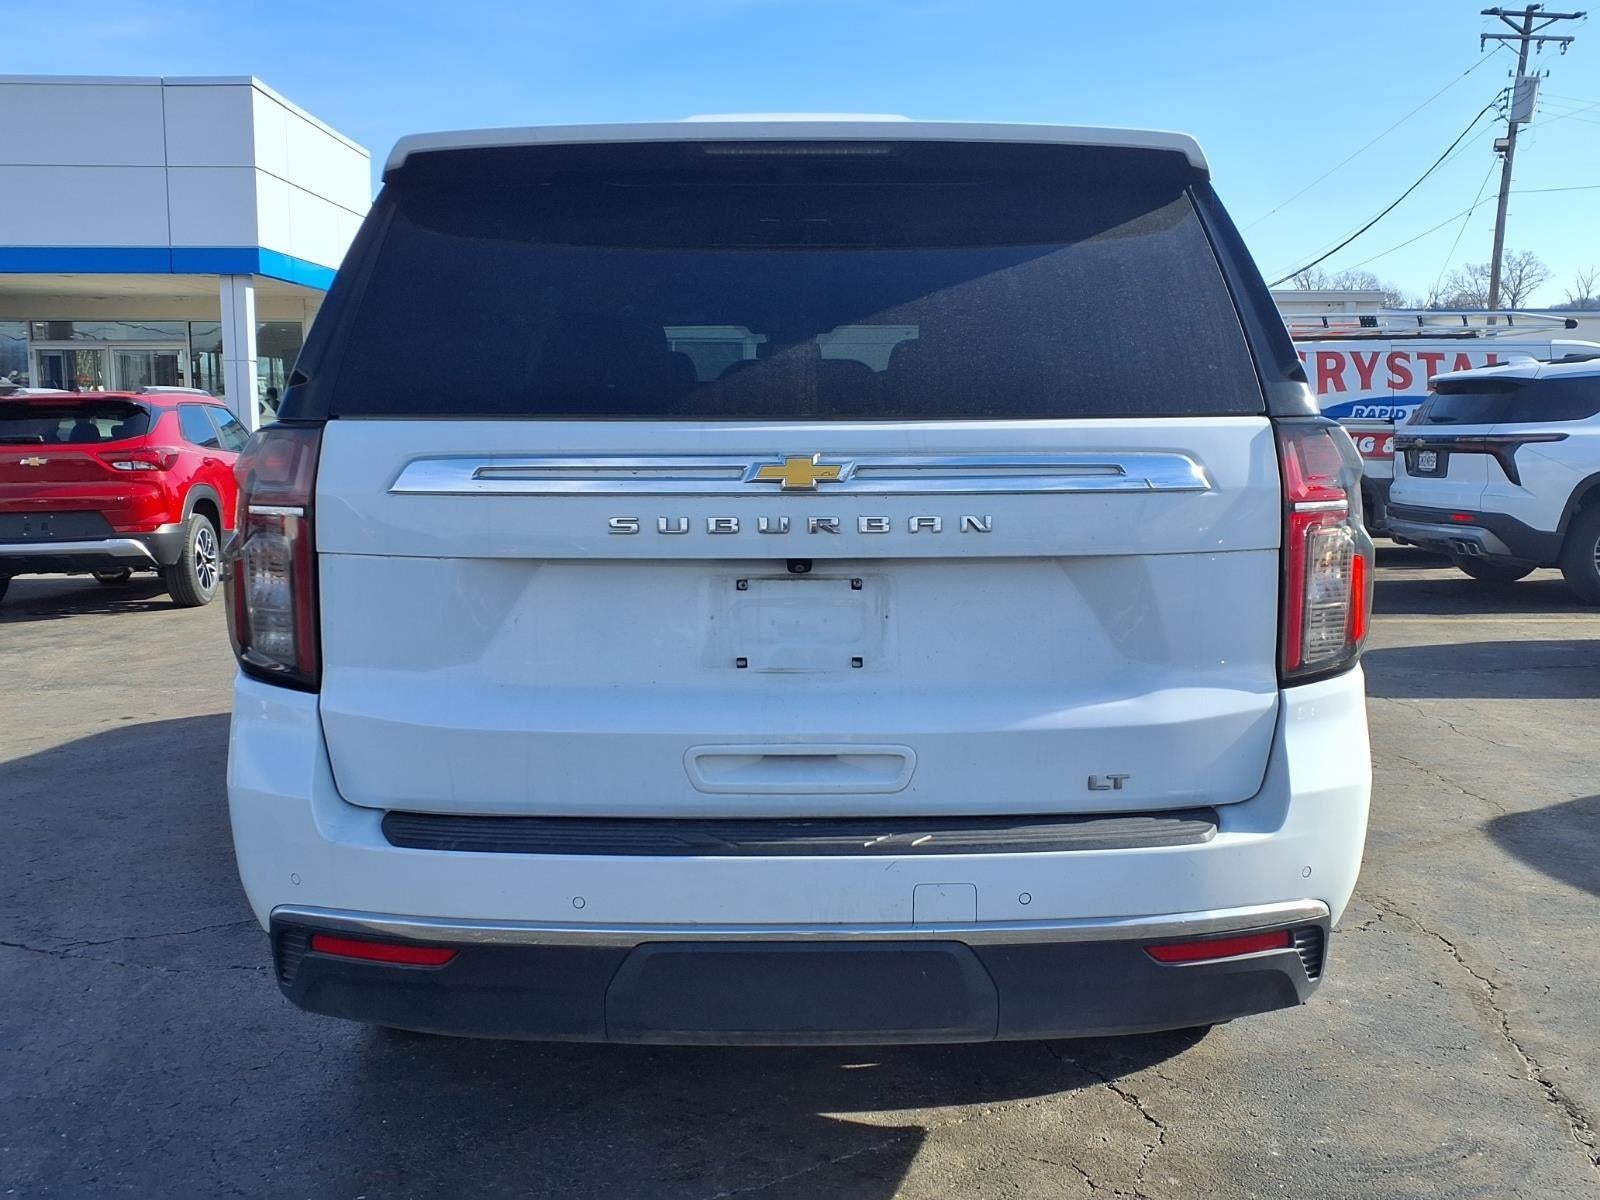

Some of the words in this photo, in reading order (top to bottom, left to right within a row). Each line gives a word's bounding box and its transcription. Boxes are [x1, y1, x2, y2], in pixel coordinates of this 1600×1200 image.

[1298, 351, 1498, 395] RYST
[1354, 408, 1407, 420] RAPID
[607, 515, 993, 535] SUBURBAN
[1087, 774, 1130, 791] LT
